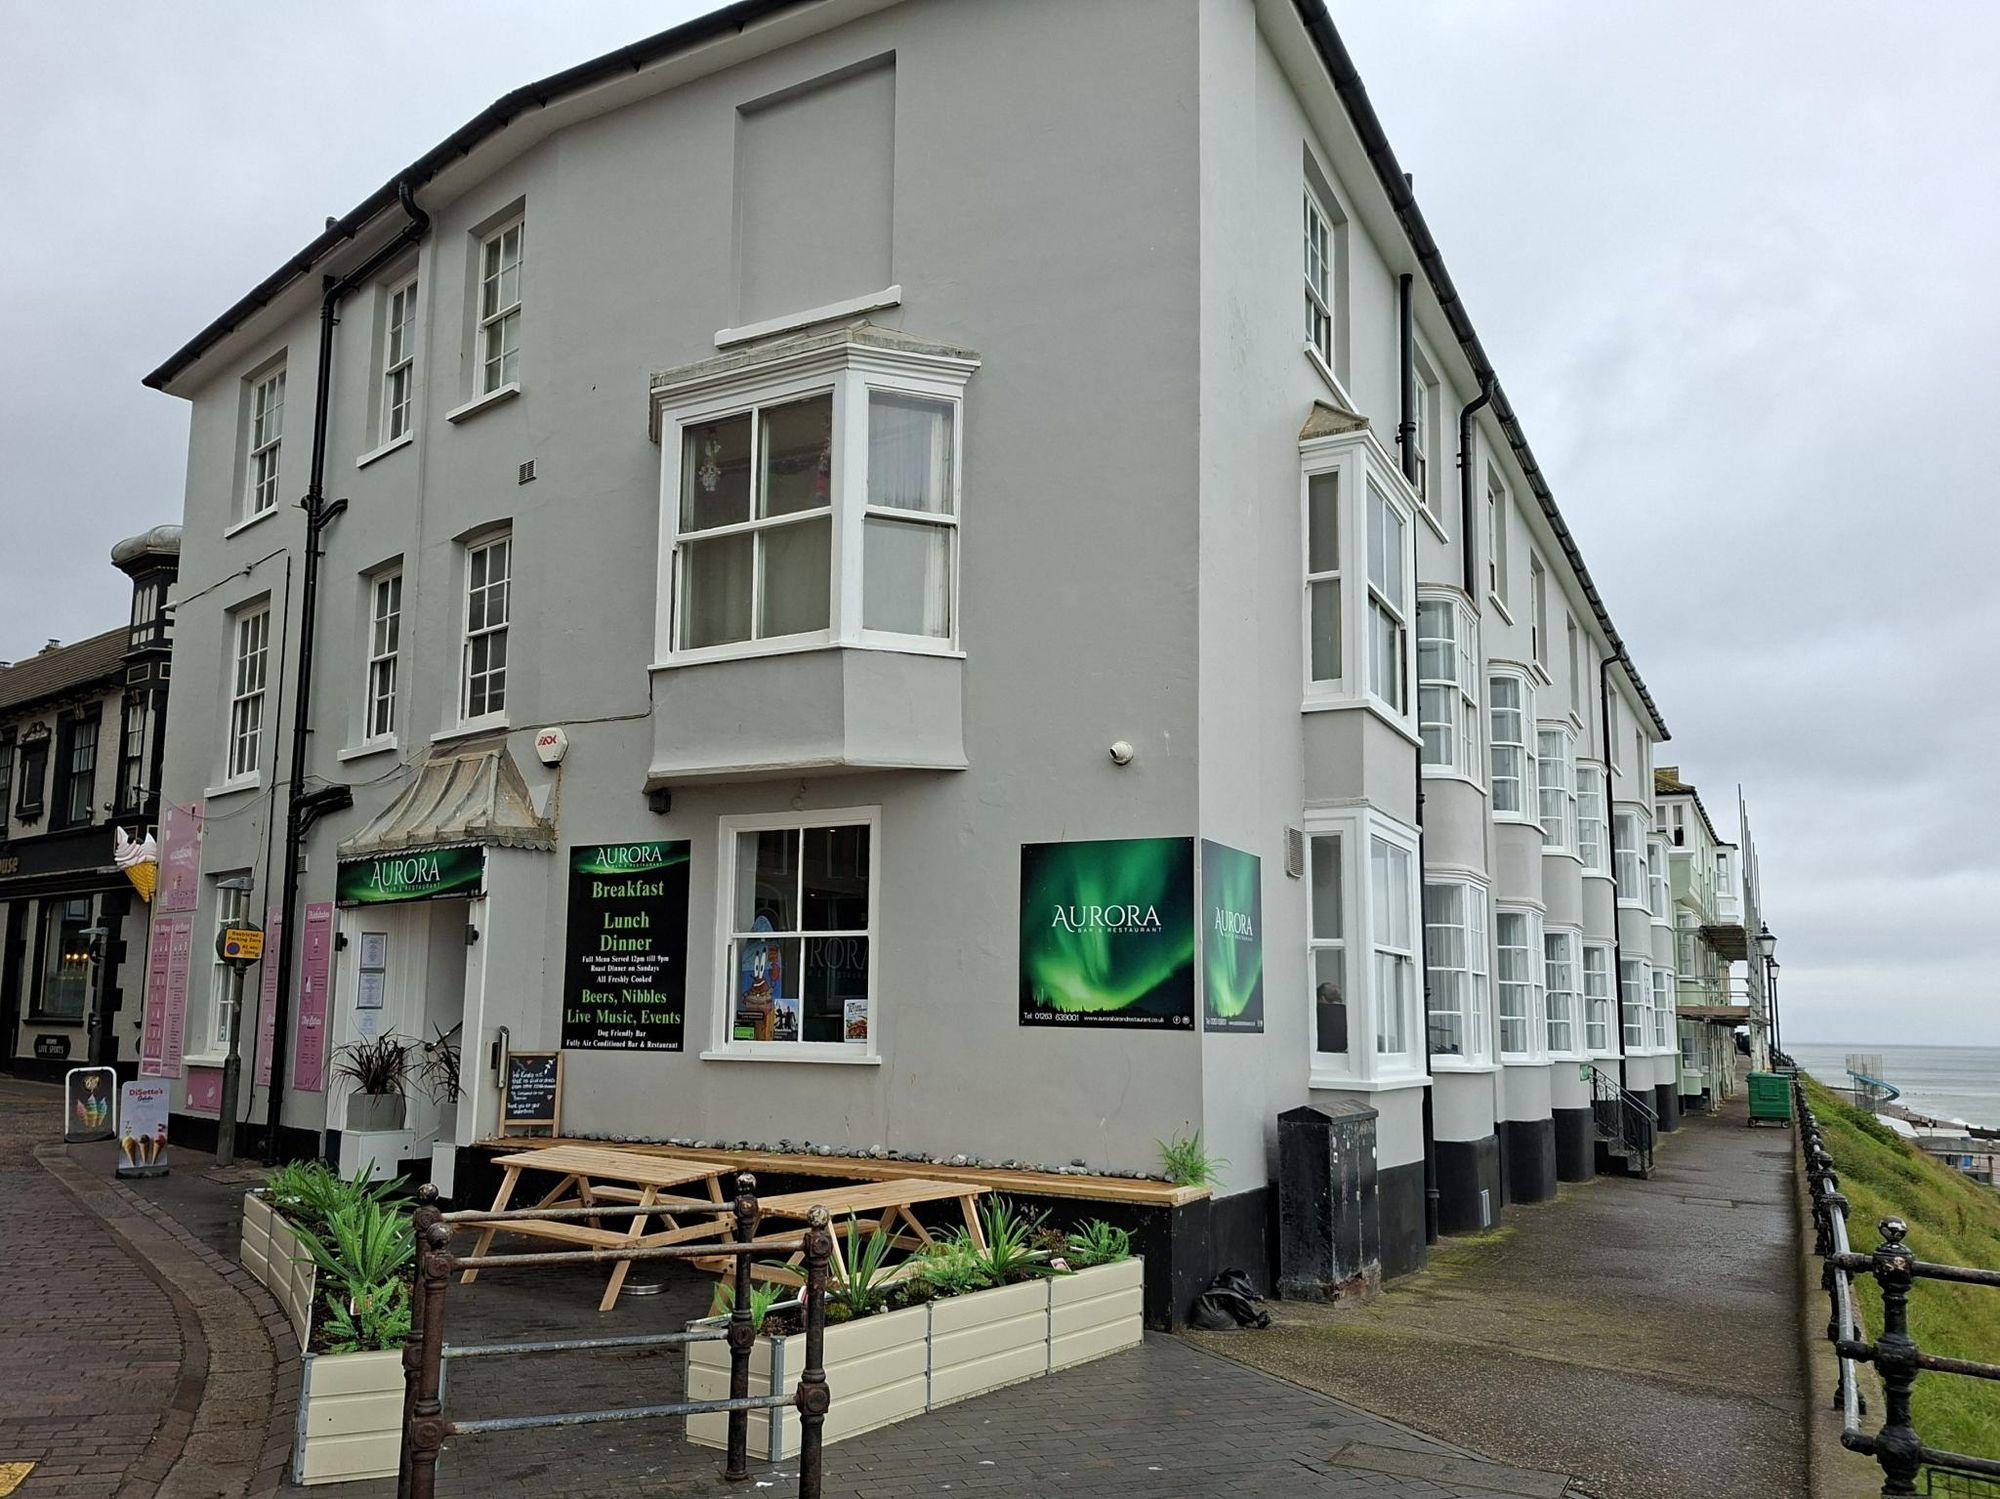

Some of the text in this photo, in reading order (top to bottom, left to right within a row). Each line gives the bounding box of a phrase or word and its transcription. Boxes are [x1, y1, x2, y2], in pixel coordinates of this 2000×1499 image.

[596, 846, 662, 868] AURORA
[370, 856, 440, 893] AURORA
[592, 880, 664, 898] Breakfast
[603, 911, 649, 929] Lunch
[1051, 905, 1161, 933] AURORA
[1215, 906, 1253, 937] AURORA
[600, 934, 652, 951] Dinner
[582, 955, 593, 963] Full
[595, 955, 610, 963] Menu
[631, 955, 645, 963] 12pm
[657, 955, 669, 963] 9pm
[636, 965, 660, 973] Sundays
[596, 975, 652, 984] All Freshly Cooked
[581, 988, 667, 1006] Beers, Nibbles
[567, 1009, 681, 1026] Live Music, Events
[597, 1029, 609, 1037] Dog
[610, 1029, 633, 1038] Friendly
[566, 1039, 580, 1047] Fully
[582, 1039, 592, 1047] Air
[627, 1040, 638, 1048] Bar
[647, 1040, 678, 1048] Restaurant
